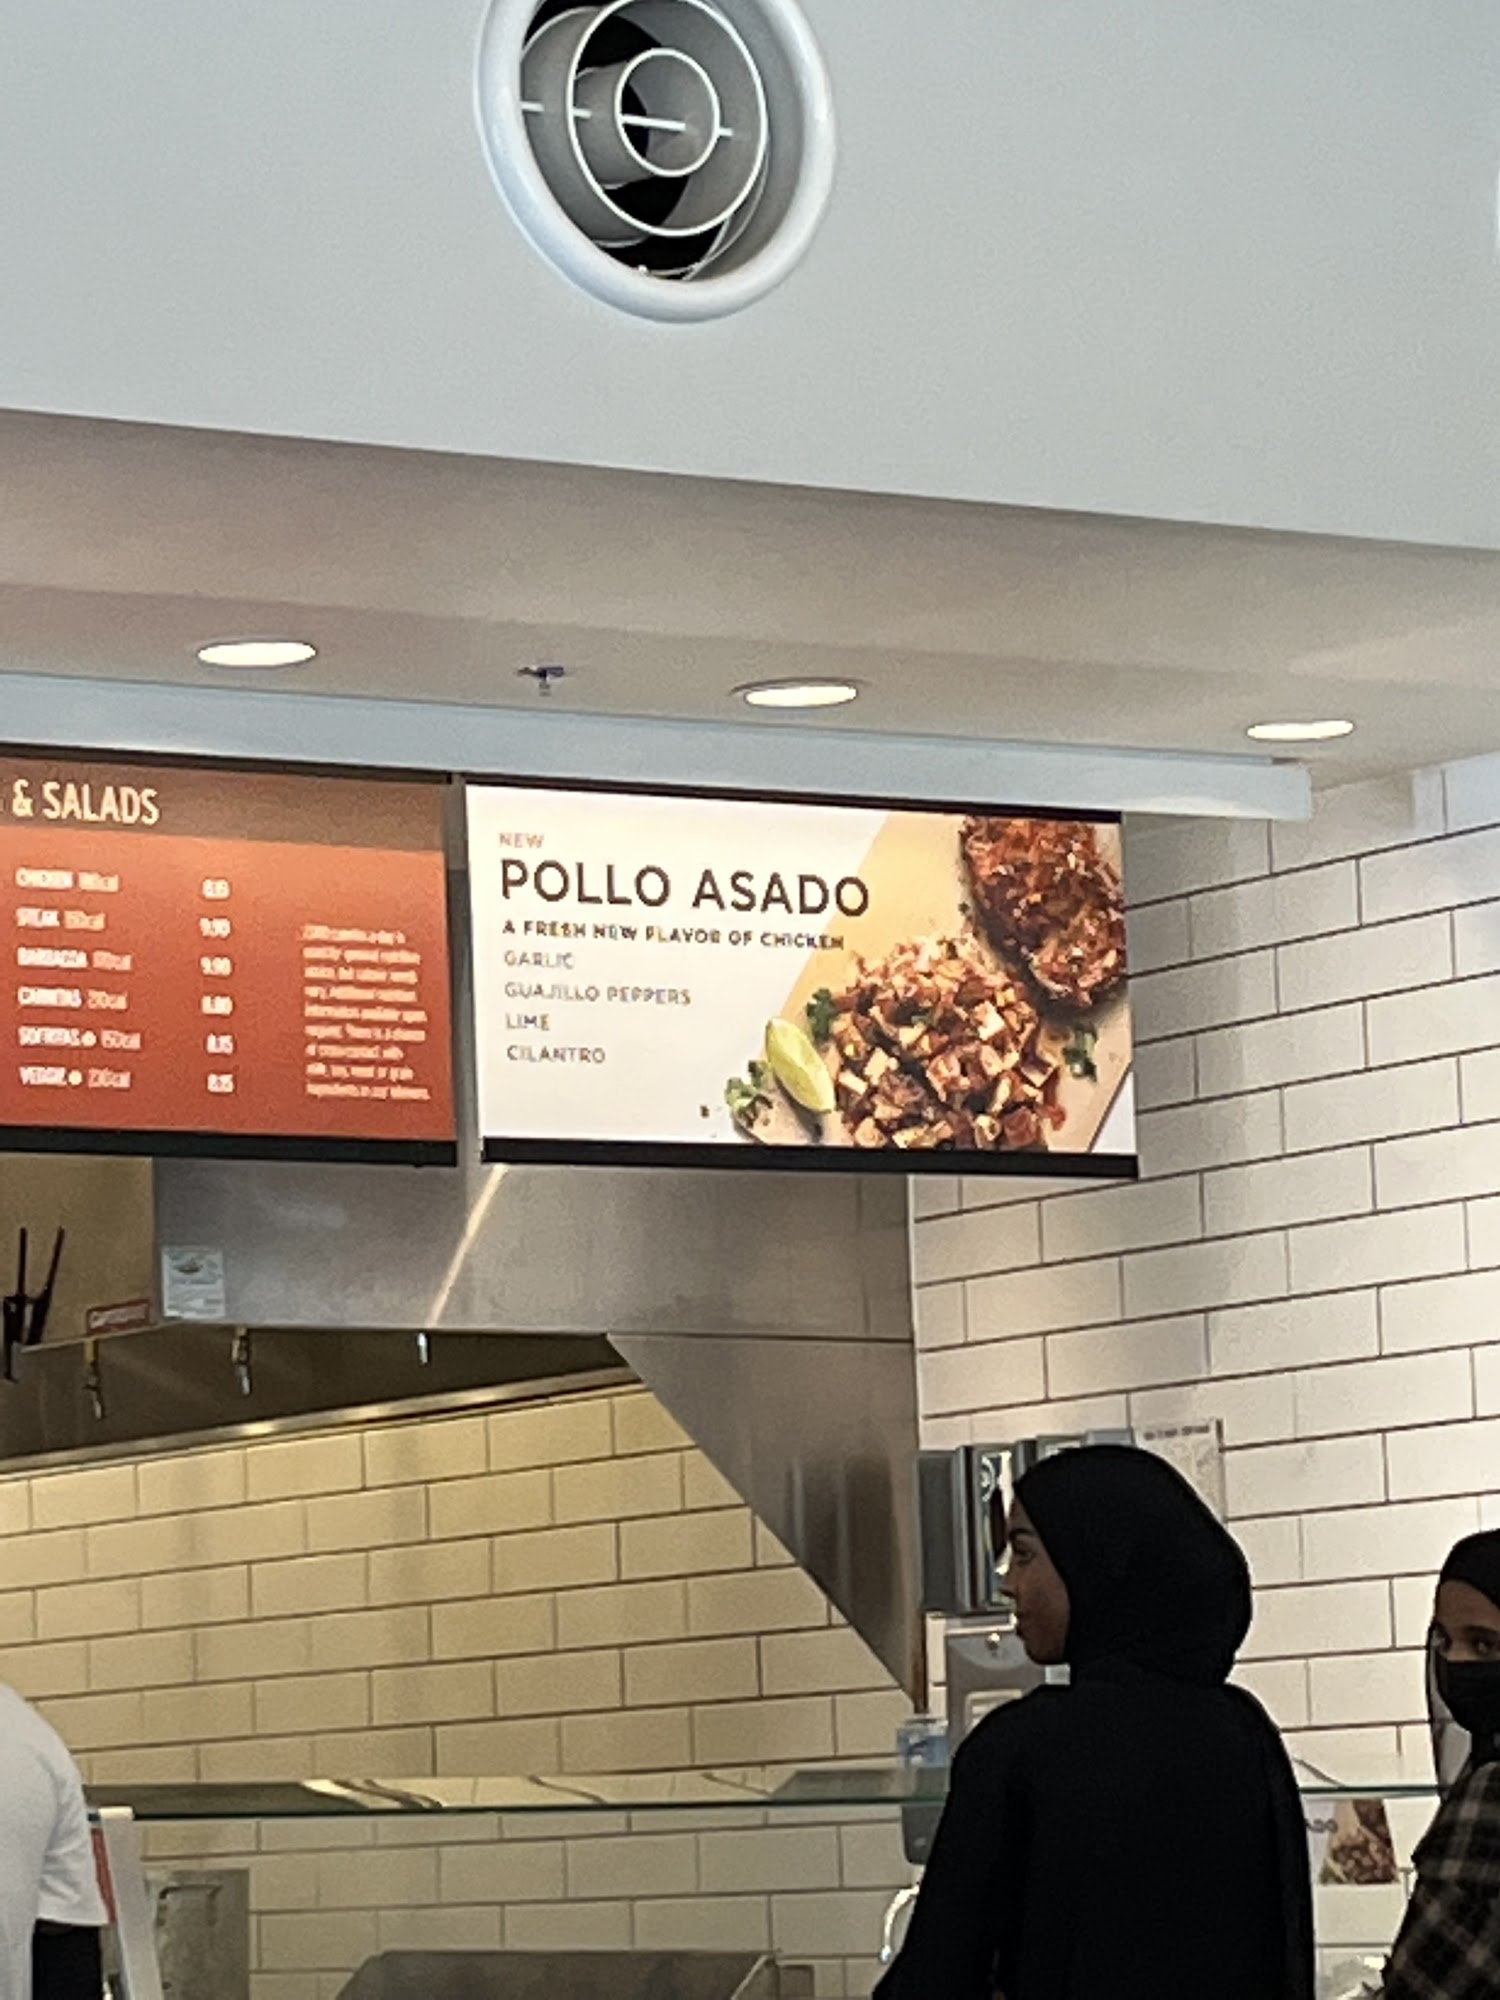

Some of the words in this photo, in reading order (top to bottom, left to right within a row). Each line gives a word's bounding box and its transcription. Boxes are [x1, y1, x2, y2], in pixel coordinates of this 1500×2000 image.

[42, 780, 161, 826] SALADS
[499, 832, 544, 850] NEW
[501, 857, 671, 907] POLLO
[692, 868, 870, 917] ASADO
[502, 918, 516, 935] A
[523, 920, 586, 938] FRESH
[593, 922, 638, 941] NEW
[645, 925, 721, 944] FLAVOR
[728, 929, 753, 946] OF
[760, 931, 845, 950] CHICKEN
[503, 949, 575, 970] GARLIC
[504, 981, 601, 1002] GUAJILLO
[606, 986, 691, 1005] PEPPERS
[505, 1012, 550, 1031] LIME
[506, 1044, 606, 1064] CILANTRO
